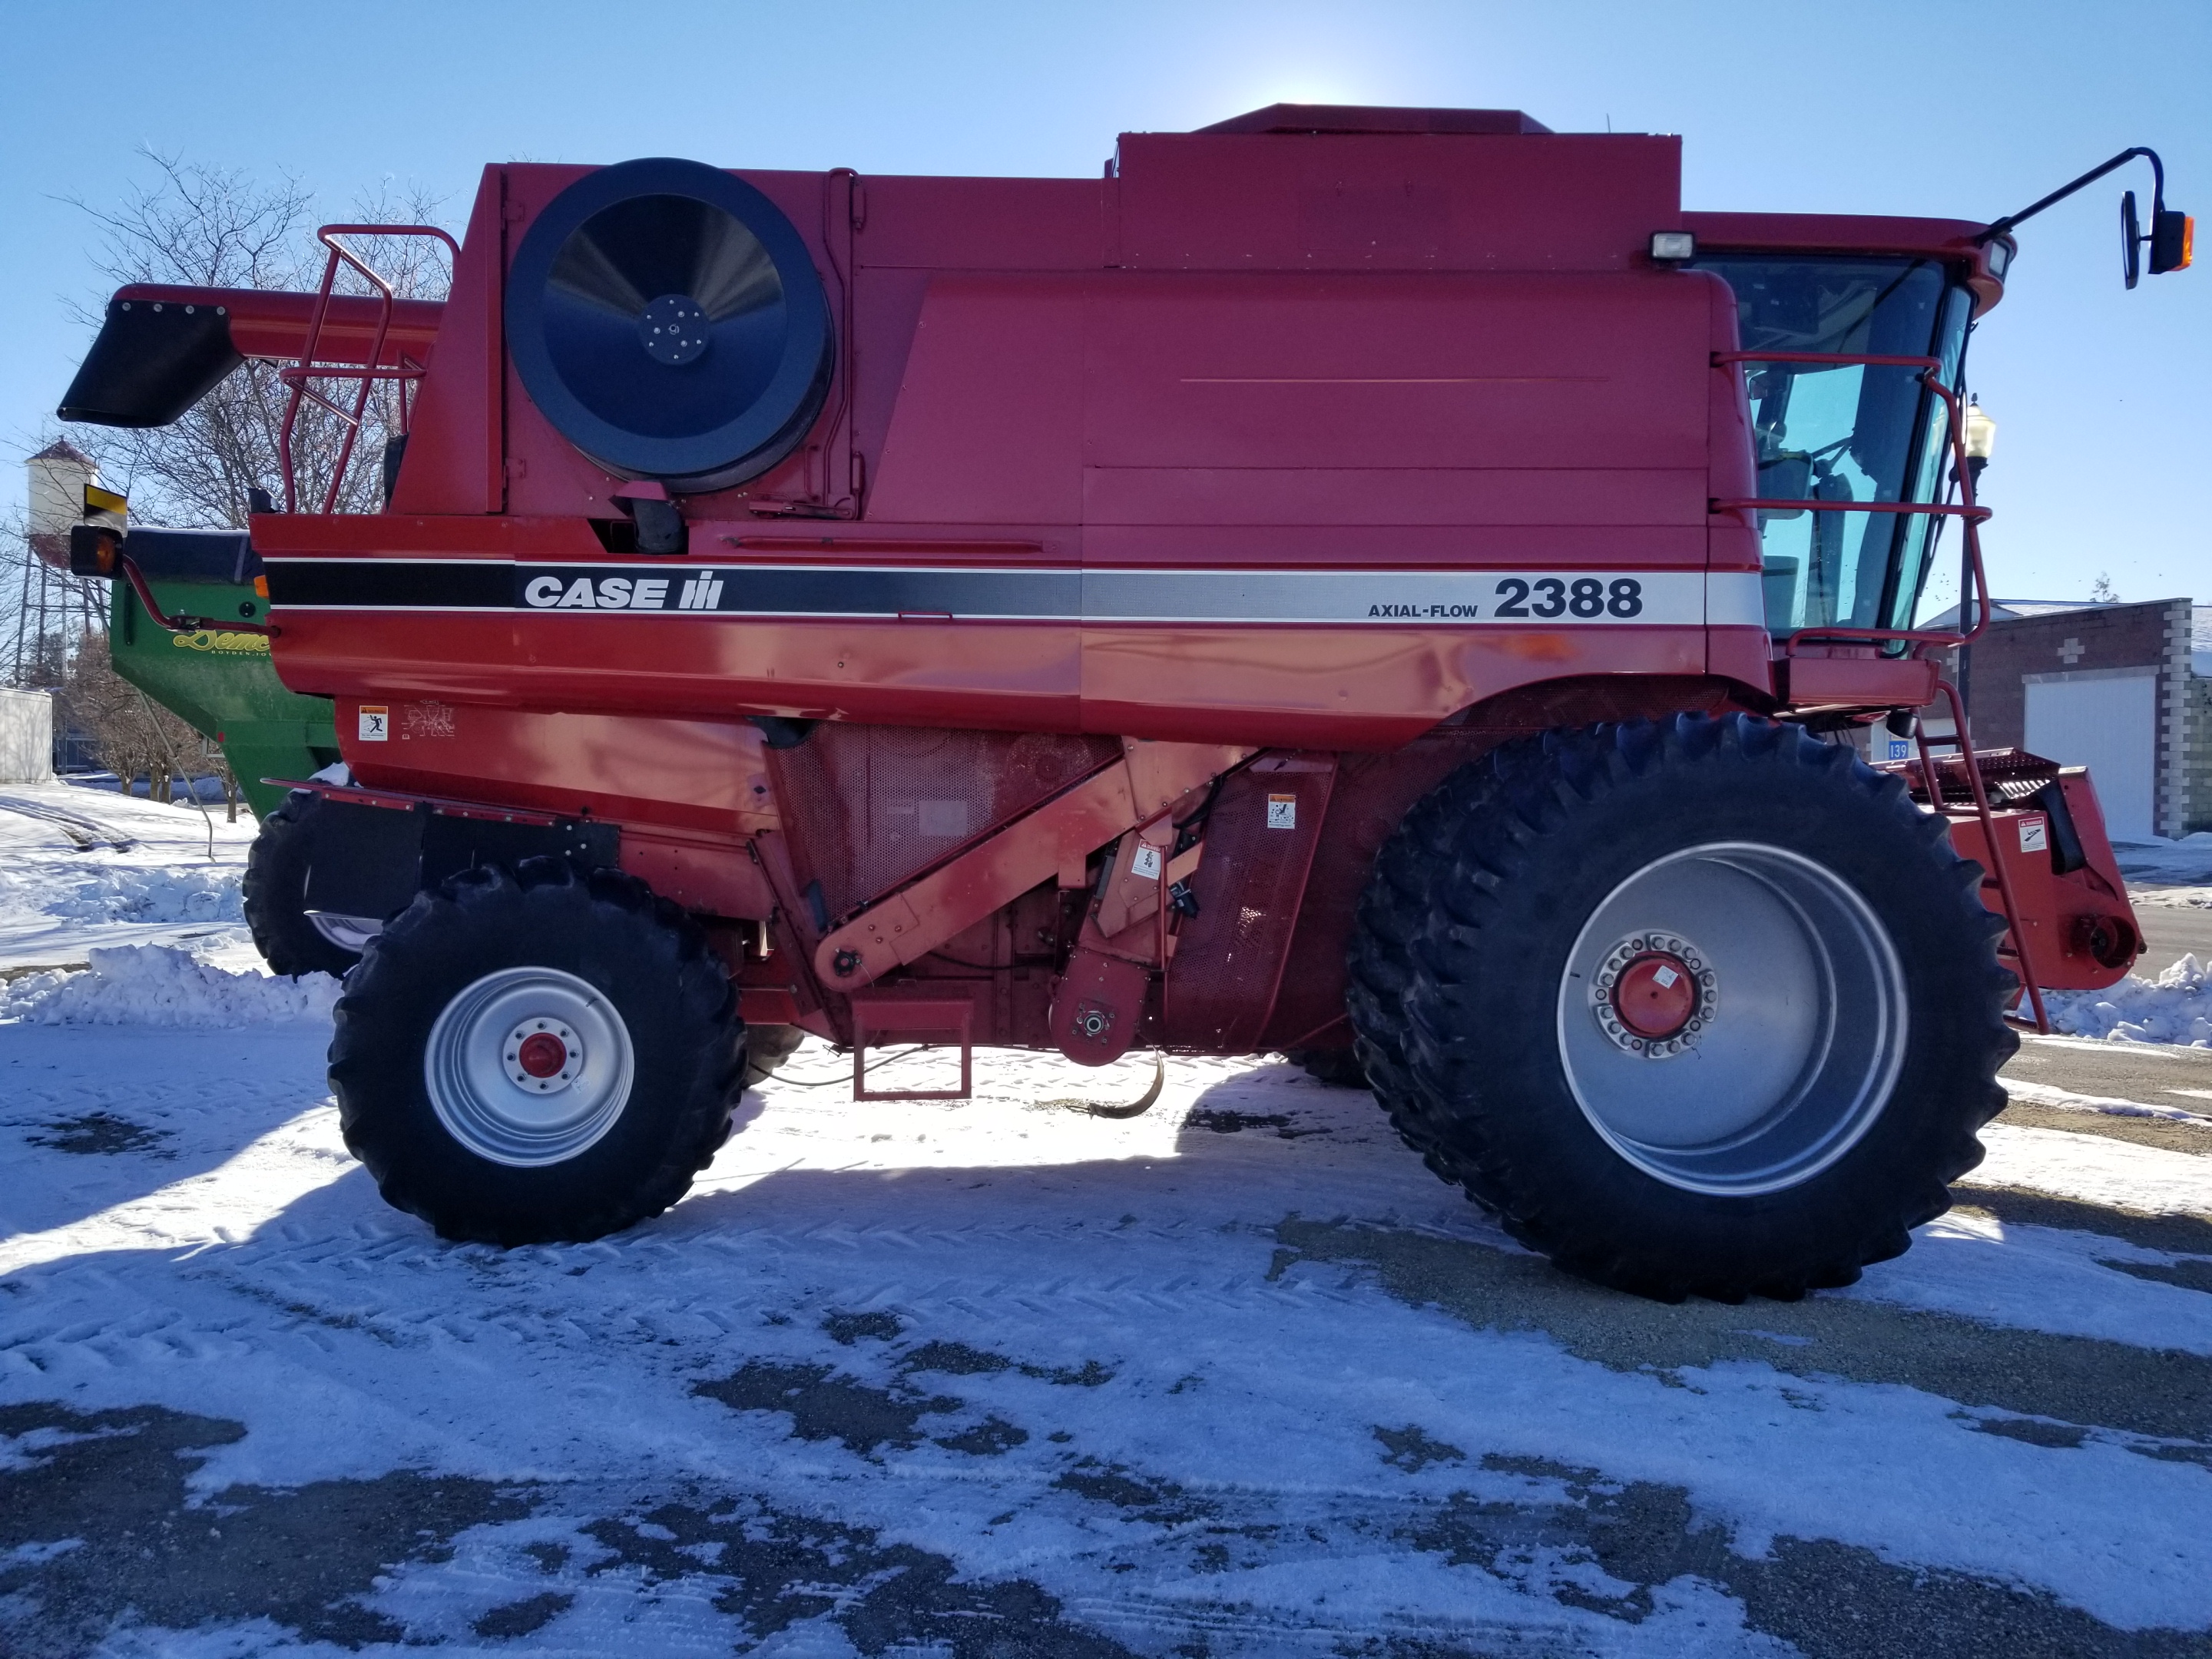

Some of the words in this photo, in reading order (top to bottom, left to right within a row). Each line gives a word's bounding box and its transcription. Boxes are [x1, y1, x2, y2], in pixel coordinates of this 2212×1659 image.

[525, 576, 670, 609] CASE
[1367, 604, 1479, 618] AXIAL-FLOW
[1493, 578, 1644, 618] 2388
[173, 629, 271, 652] Demc
[1890, 744, 1907, 758] 139
[1147, 844, 1168, 853] DANG
